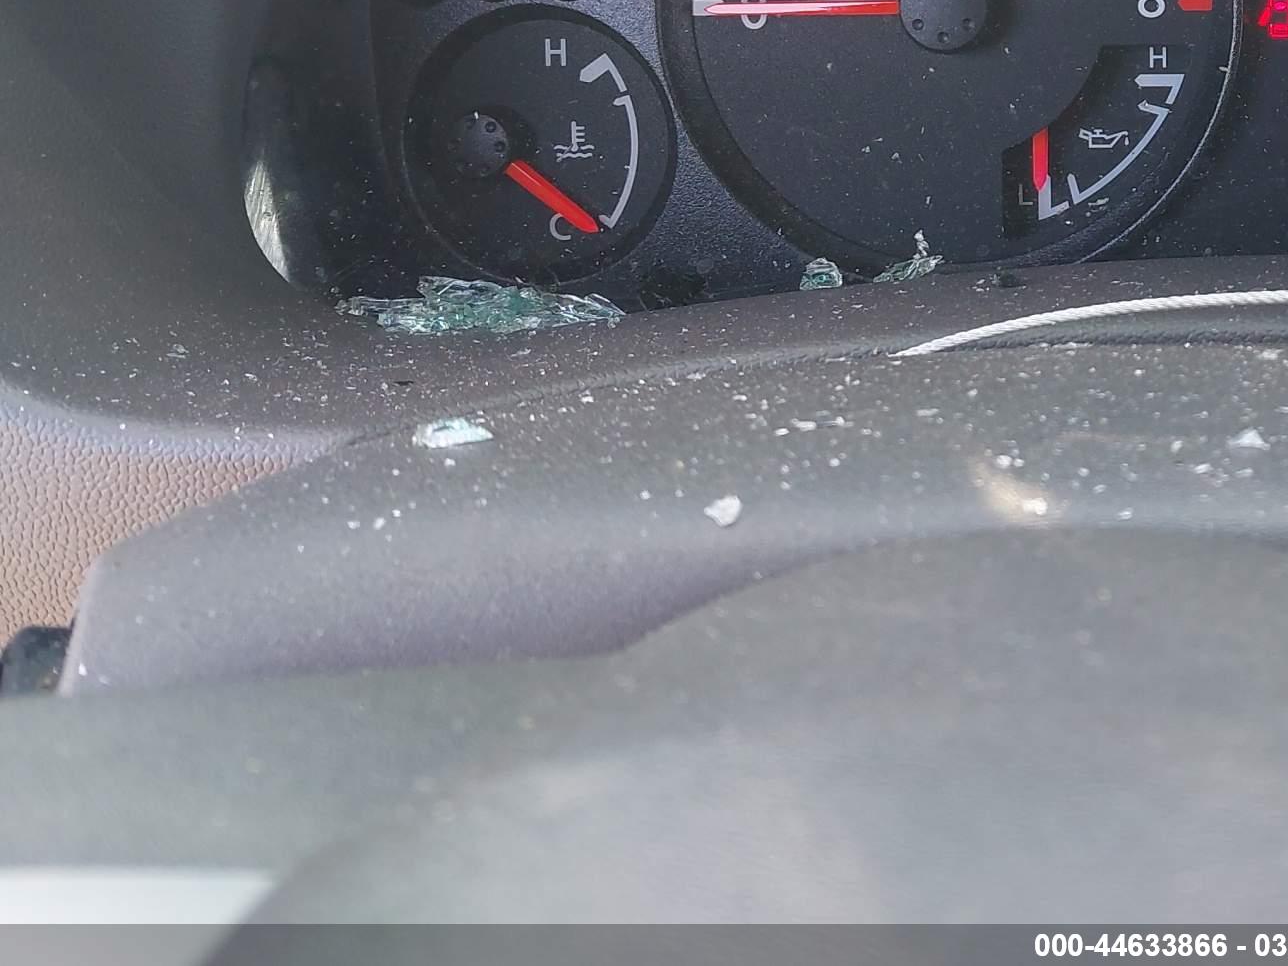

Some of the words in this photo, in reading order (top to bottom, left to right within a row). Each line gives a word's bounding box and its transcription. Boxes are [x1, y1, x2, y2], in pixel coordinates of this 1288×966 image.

[545, 39, 567, 67] H
[1149, 48, 1167, 68] H
[1018, 185, 1033, 207] L
[549, 213, 572, 242] C
